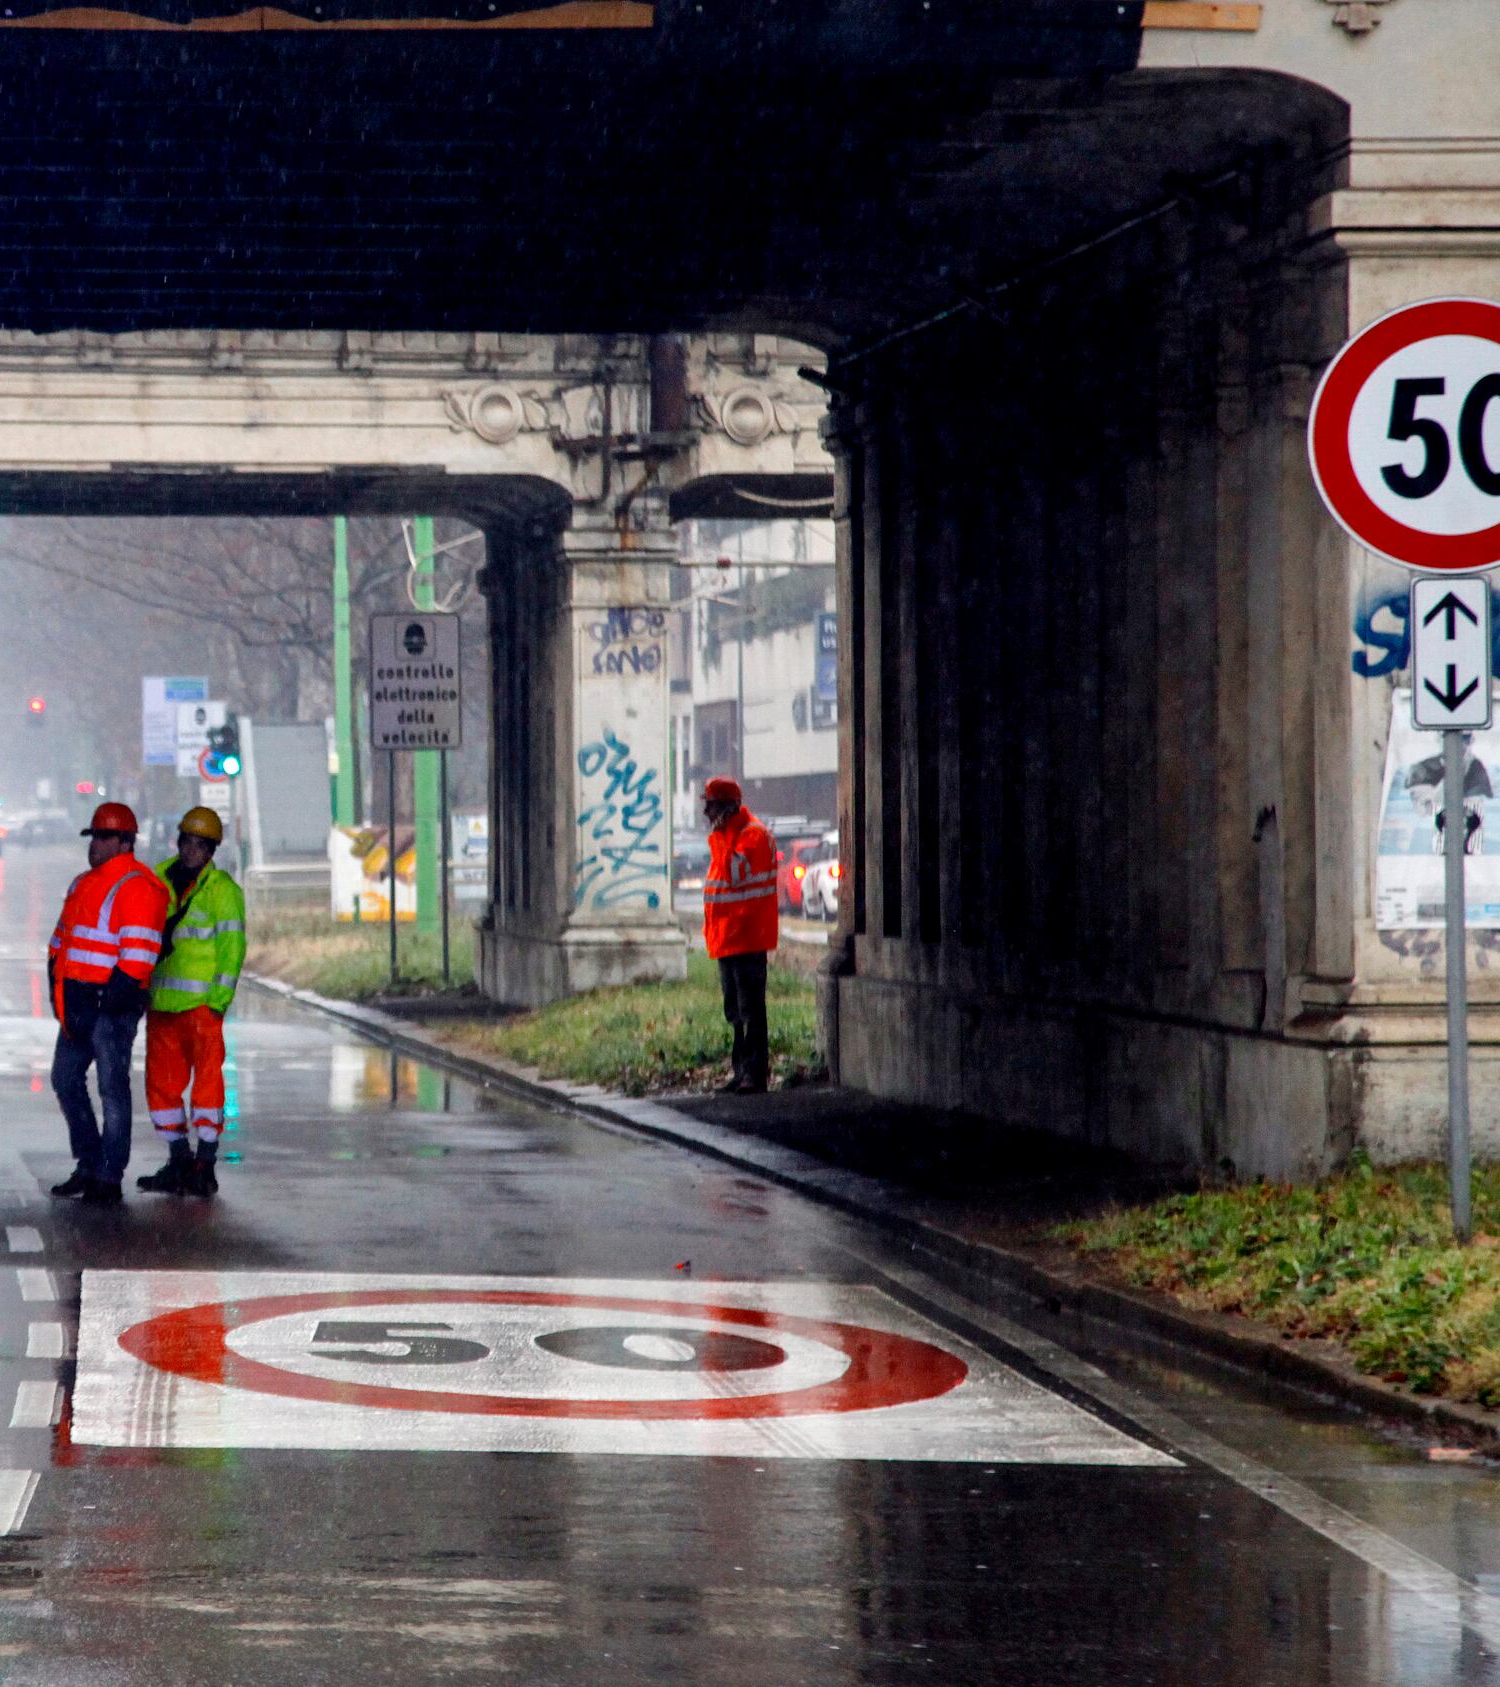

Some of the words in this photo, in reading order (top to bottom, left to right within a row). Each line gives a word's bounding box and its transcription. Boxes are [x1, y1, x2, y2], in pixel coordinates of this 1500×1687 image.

[1380, 372, 1500, 499] 50
[377, 664, 454, 680] controllo
[375, 686, 457, 702] elettronico
[397, 709, 435, 725] della
[310, 1321, 786, 1371] 50
